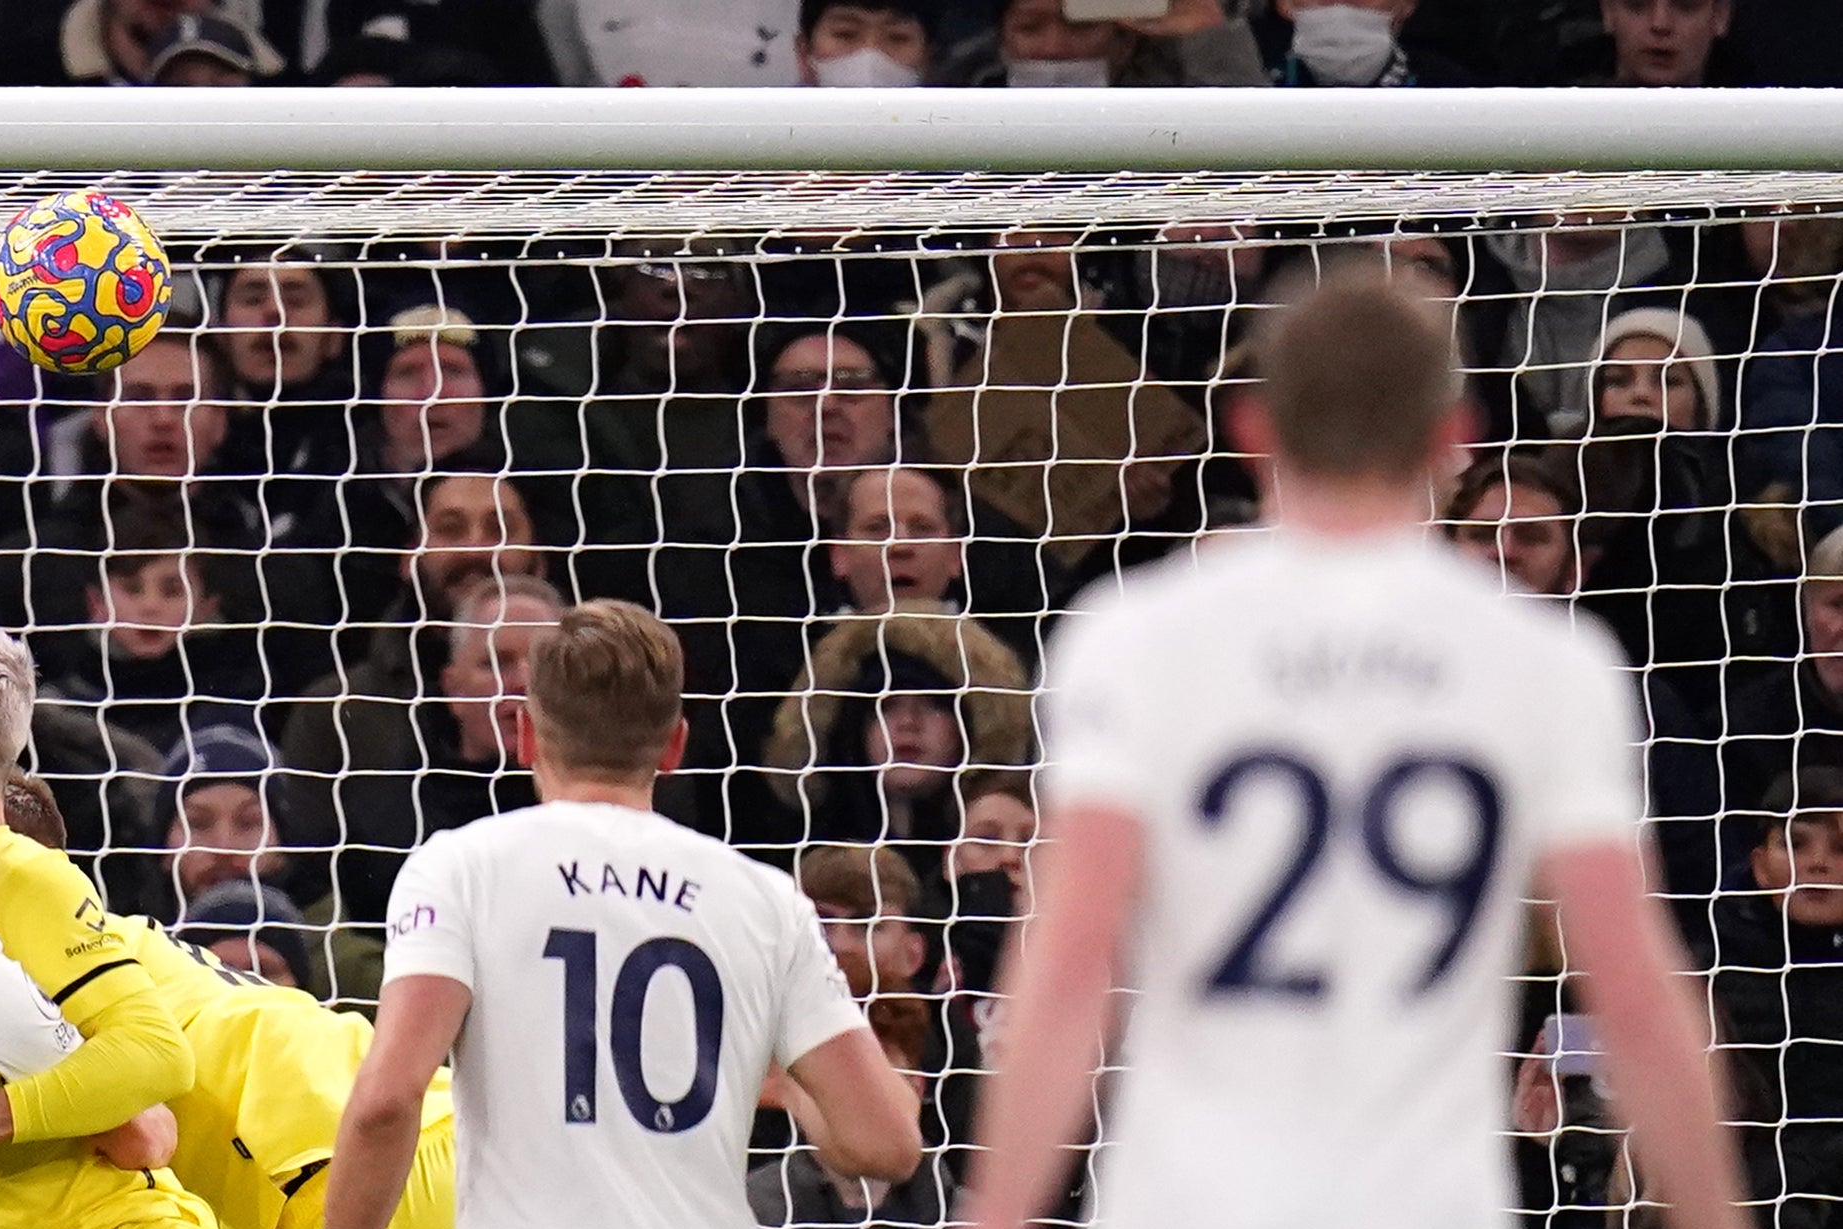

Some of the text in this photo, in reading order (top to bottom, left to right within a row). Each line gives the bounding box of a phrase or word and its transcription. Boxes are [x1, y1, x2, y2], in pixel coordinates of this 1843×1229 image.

[557, 862, 702, 913] KANE
[1192, 747, 1503, 1002] 29
[542, 926, 725, 1135] 10
